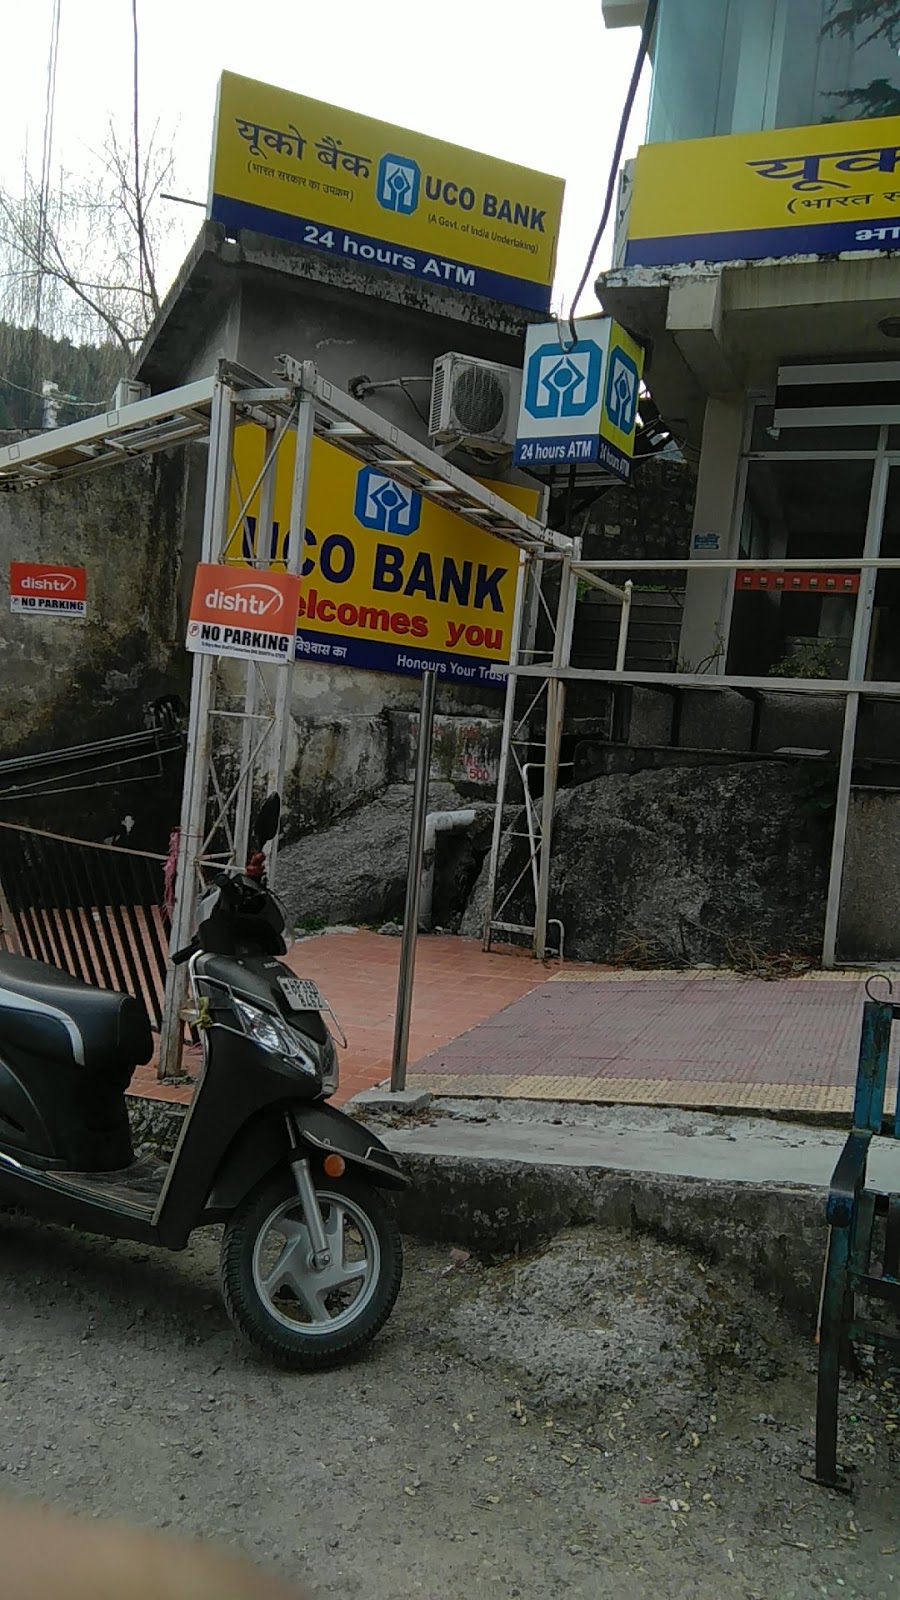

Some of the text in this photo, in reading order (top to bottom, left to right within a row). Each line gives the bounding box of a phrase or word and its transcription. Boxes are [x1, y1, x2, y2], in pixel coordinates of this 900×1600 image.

[235, 118, 373, 180] यूको बैंक
[247, 160, 275, 177] (भारत
[278, 170, 306, 187] सरकार
[308, 179, 320, 191] का
[425, 175, 548, 233] UCO BANK
[786, 193, 875, 214] (भारत
[438, 216, 459, 230] Govt.
[461, 224, 469, 232] of
[471, 226, 490, 239] India
[491, 231, 539, 255] Undertaking)
[303, 224, 477, 287] 24 hours ATM
[520, 440, 593, 460] 24 hours ATM
[20, 575, 75, 591] dishtv
[372, 543, 509, 613] BANK
[21, 597, 36, 606] NO
[38, 599, 84, 611] PARKING
[205, 586, 282, 616] dishtv
[201, 624, 220, 641] NO
[224, 627, 290, 652] PARKING
[445, 620, 504, 650] you
[332, 645, 348, 659] का
[396, 653, 447, 673] Honours
[449, 661, 476, 677] Your
[469, 768, 490, 781] 500
